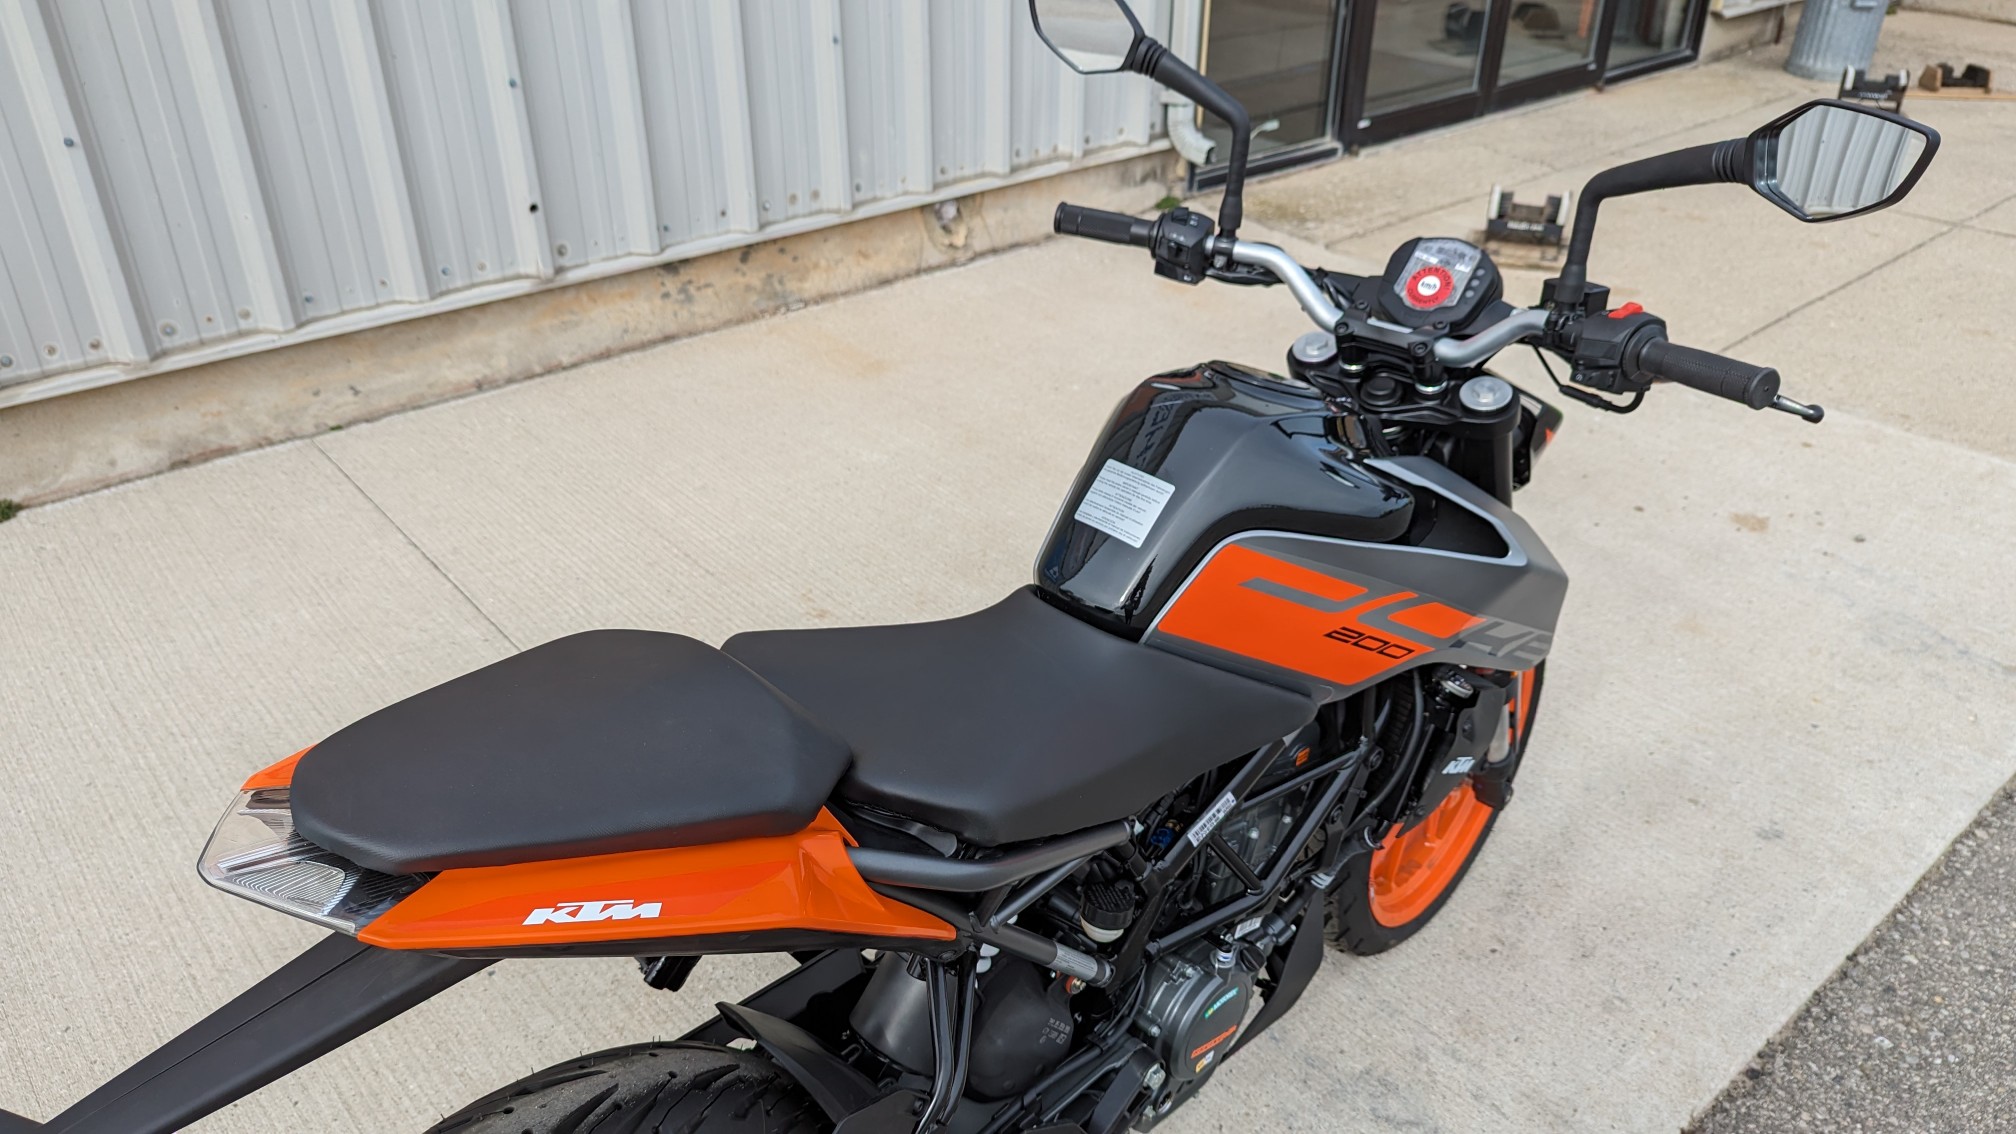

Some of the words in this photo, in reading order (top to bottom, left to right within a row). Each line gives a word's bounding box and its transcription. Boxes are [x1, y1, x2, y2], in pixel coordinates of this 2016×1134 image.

[1323, 626, 1415, 659] 200
[1441, 756, 1476, 775] KTM
[522, 899, 663, 926] KTM
